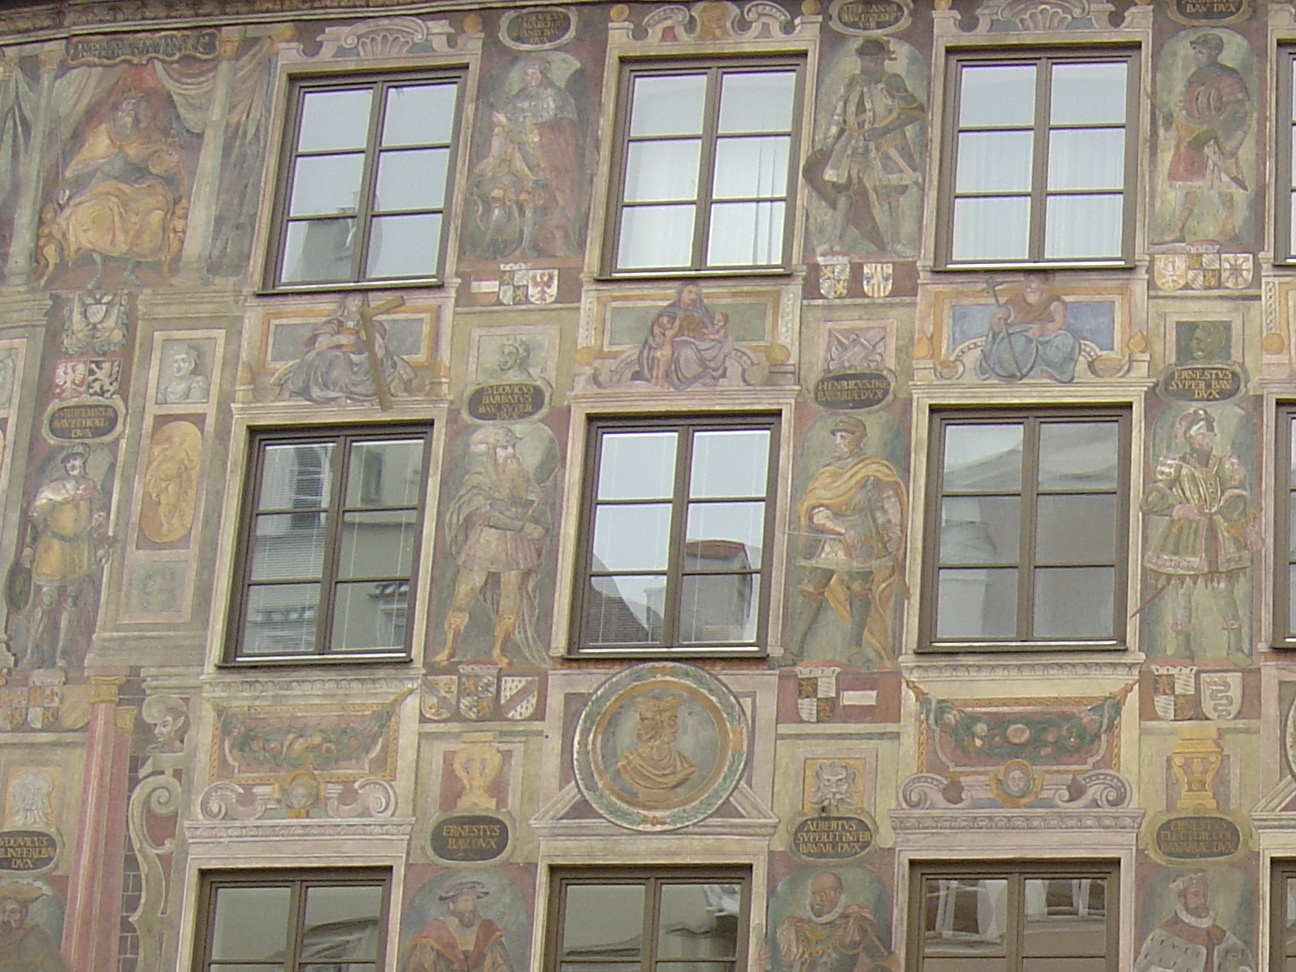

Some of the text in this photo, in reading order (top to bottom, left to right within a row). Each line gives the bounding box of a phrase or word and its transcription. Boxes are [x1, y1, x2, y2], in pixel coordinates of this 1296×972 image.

[1174, 369, 1233, 380] ERNESTVS
[1168, 379, 1206, 391] SVPER
[1194, 389, 1220, 399] DVX
[442, 825, 502, 836] ERNESTVS
[804, 820, 858, 831] ALBERTVS
[837, 842, 862, 853] DVX
